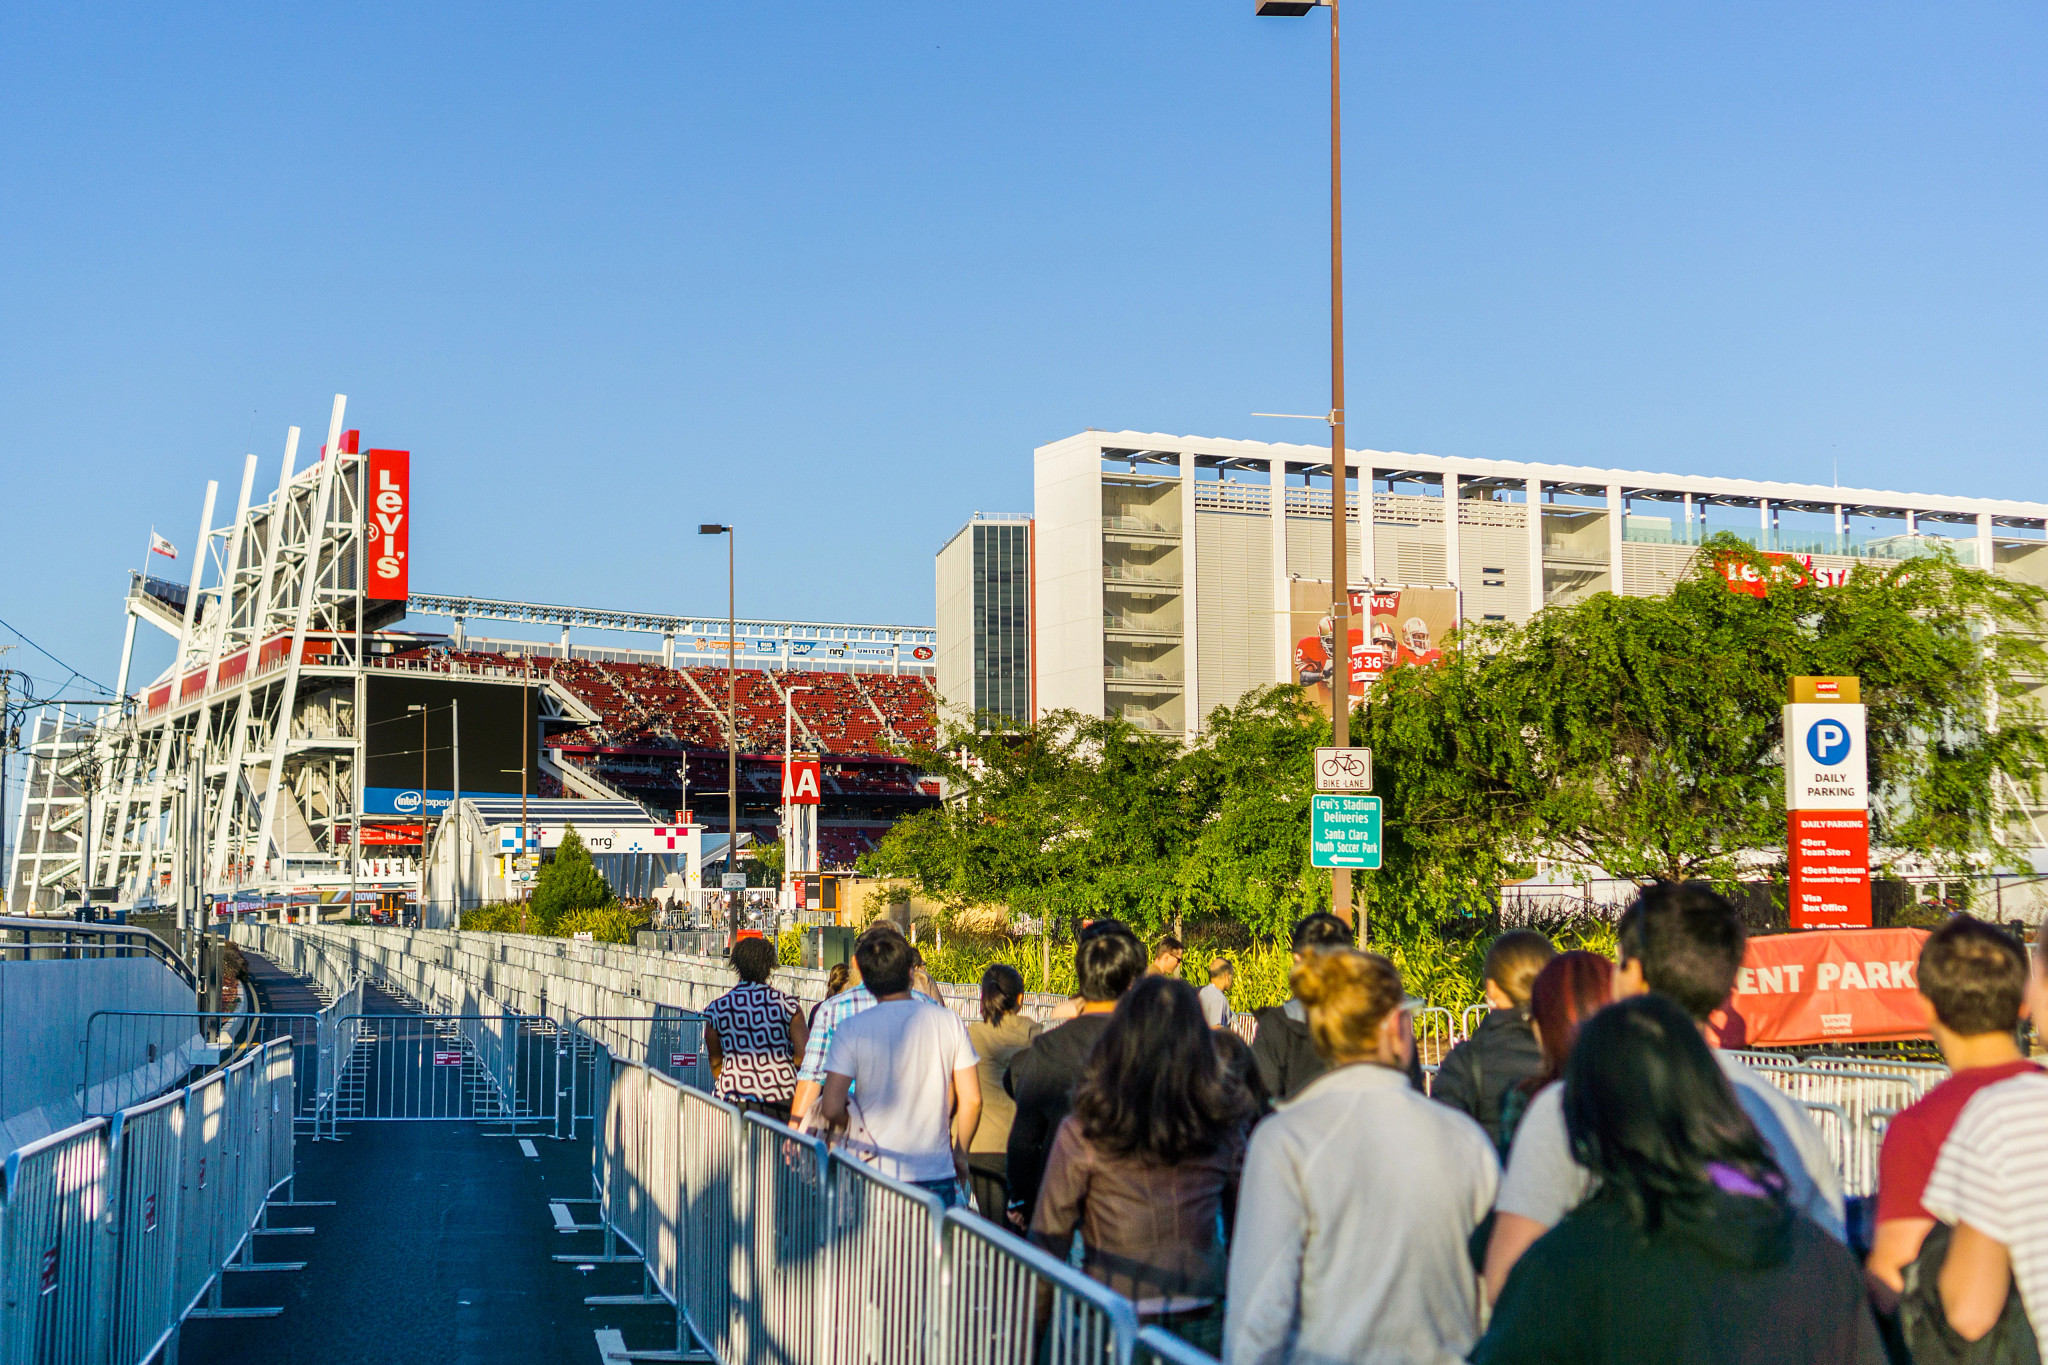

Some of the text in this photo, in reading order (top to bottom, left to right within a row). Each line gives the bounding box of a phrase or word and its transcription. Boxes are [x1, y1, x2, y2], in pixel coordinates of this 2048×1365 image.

[794, 644, 811, 653] SAP
[829, 648, 844, 657] nrg
[1353, 656, 1363, 670] 36
[1363, 656, 1381, 669] 36
[1817, 724, 1843, 758] P
[796, 769, 819, 797] A
[1815, 773, 1847, 783] DAILY
[1323, 779, 1364, 788] BIKE LANE
[1807, 787, 1855, 797] PARKING
[1316, 798, 1377, 811] Levi's Stadium
[1323, 811, 1369, 824] Deliveries
[1800, 820, 1864, 828] DAILY PARKING
[1324, 828, 1368, 841] Santa Clara
[590, 836, 612, 849] nrg
[1315, 841, 1378, 854] Youth Soccer Park
[1800, 838, 1827, 847] 49ers
[1800, 848, 1851, 856] Team Store
[1801, 866, 1866, 875] 49ers Museum
[1835, 876, 1844, 884] by
[1801, 894, 1822, 902] Visa
[1802, 904, 1848, 912] Box Office
